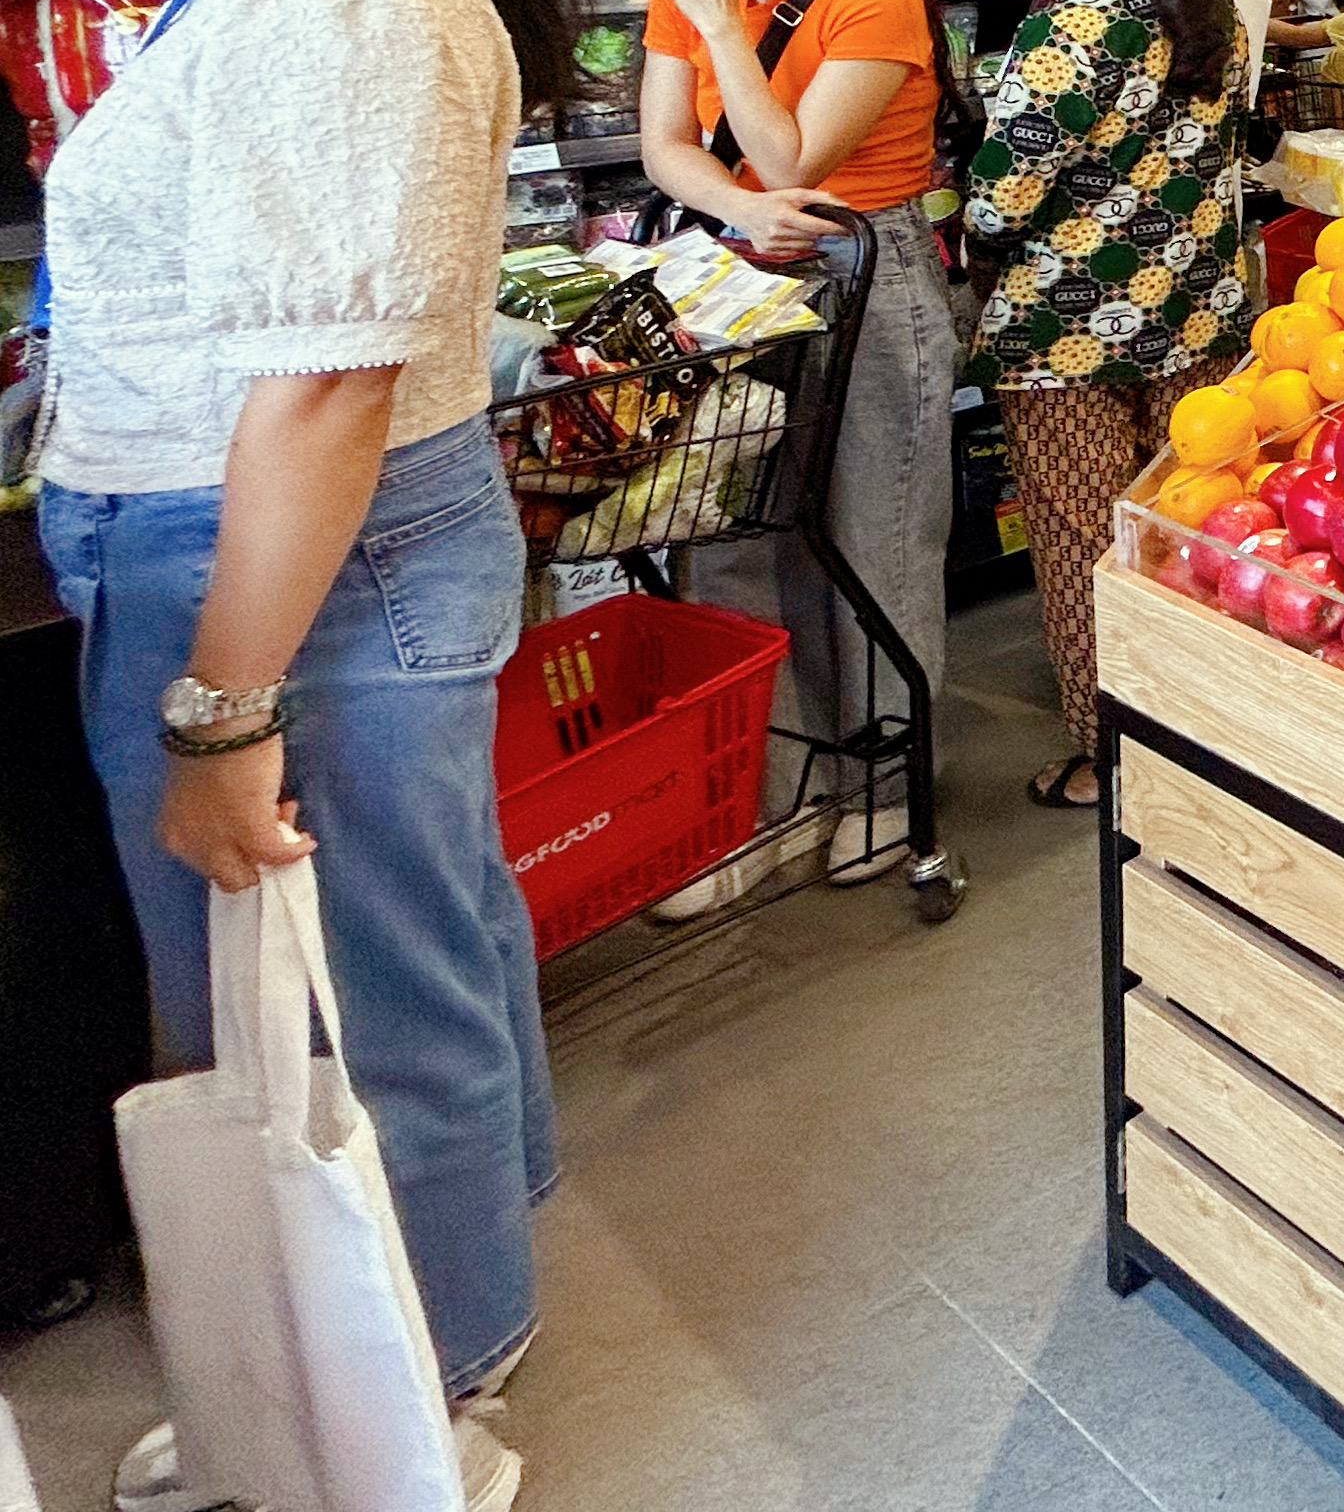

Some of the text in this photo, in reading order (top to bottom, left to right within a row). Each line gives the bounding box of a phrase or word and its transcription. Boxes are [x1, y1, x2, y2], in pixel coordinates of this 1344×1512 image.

[1012, 126, 1055, 144] GUCCI
[1072, 174, 1113, 188] GUCCI
[1055, 291, 1096, 302] GUCCI
[636, 310, 694, 384] BISTO
[508, 811, 611, 874] GFOOD
